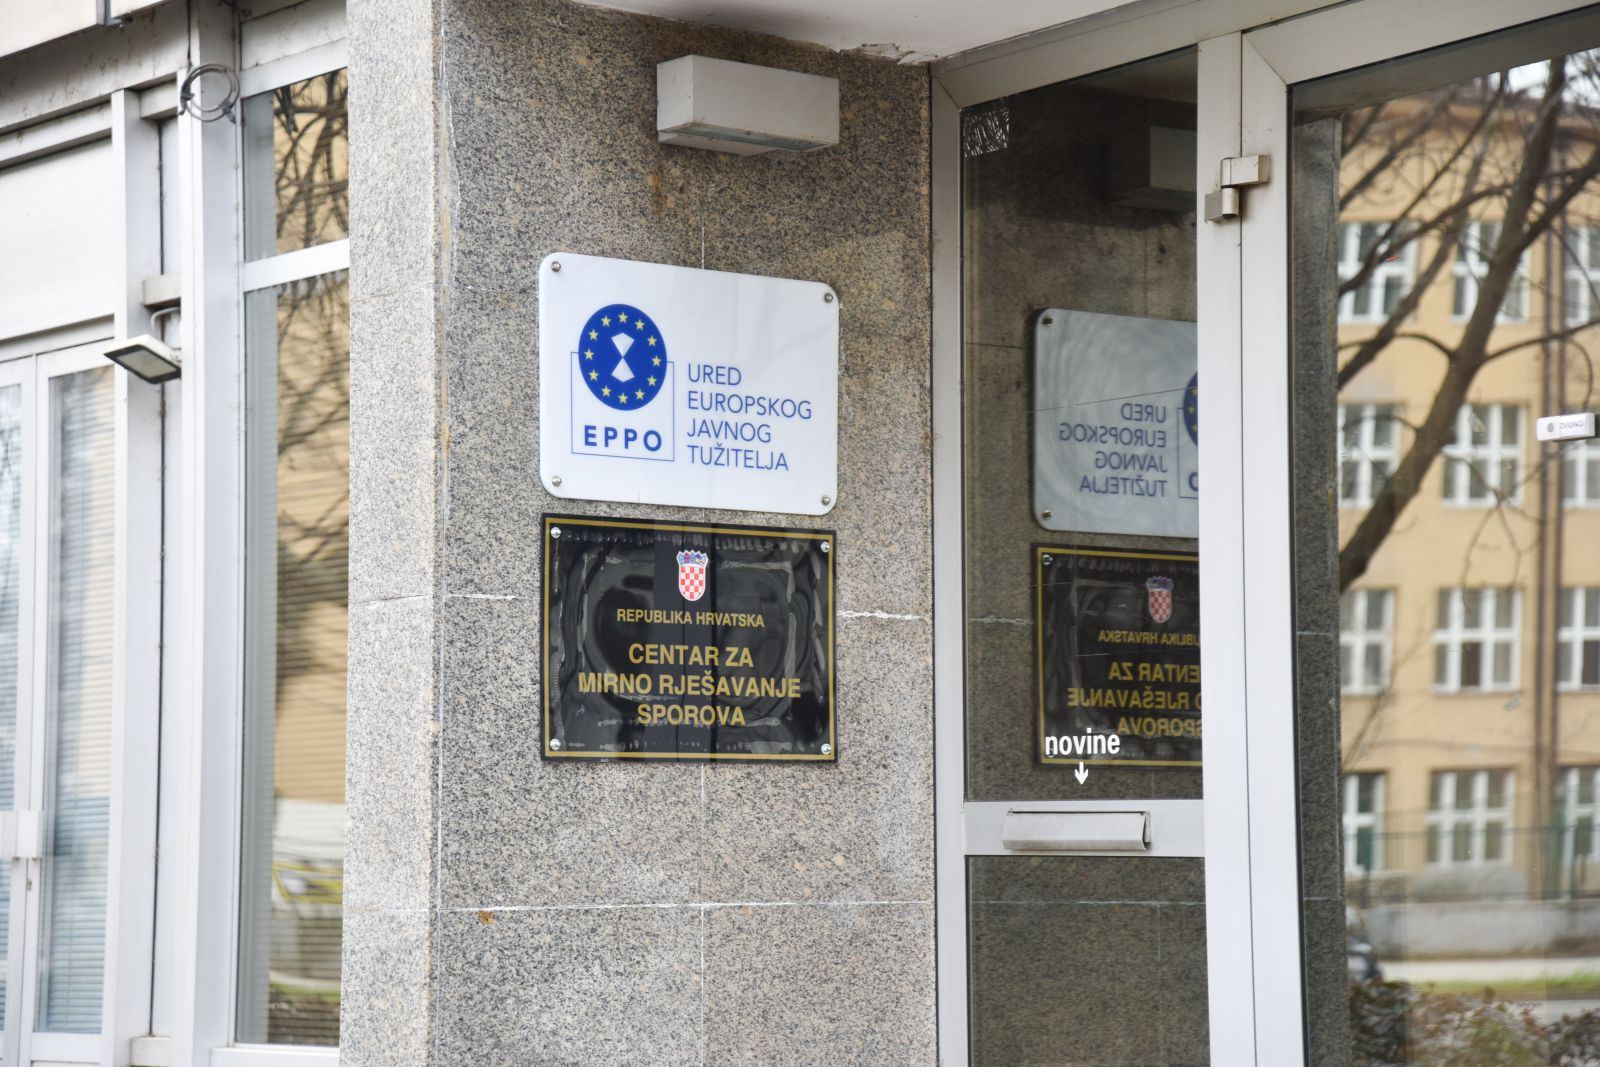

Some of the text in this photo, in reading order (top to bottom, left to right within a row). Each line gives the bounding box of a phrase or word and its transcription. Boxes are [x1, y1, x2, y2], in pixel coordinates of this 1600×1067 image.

[688, 363, 742, 386] URED
[688, 390, 812, 419] EUROPSKOG
[584, 425, 662, 452] EPPO
[687, 418, 771, 443] JAVNOG
[687, 444, 789, 471] TUŽITELJA
[617, 608, 765, 628] REPUBLIKA HRVATSKA
[628, 643, 754, 667] CENTAR ZA
[578, 670, 801, 698] MIRNO RJEŠAVANJE
[637, 704, 746, 726] SPOROVA
[1045, 727, 1121, 756] novine
